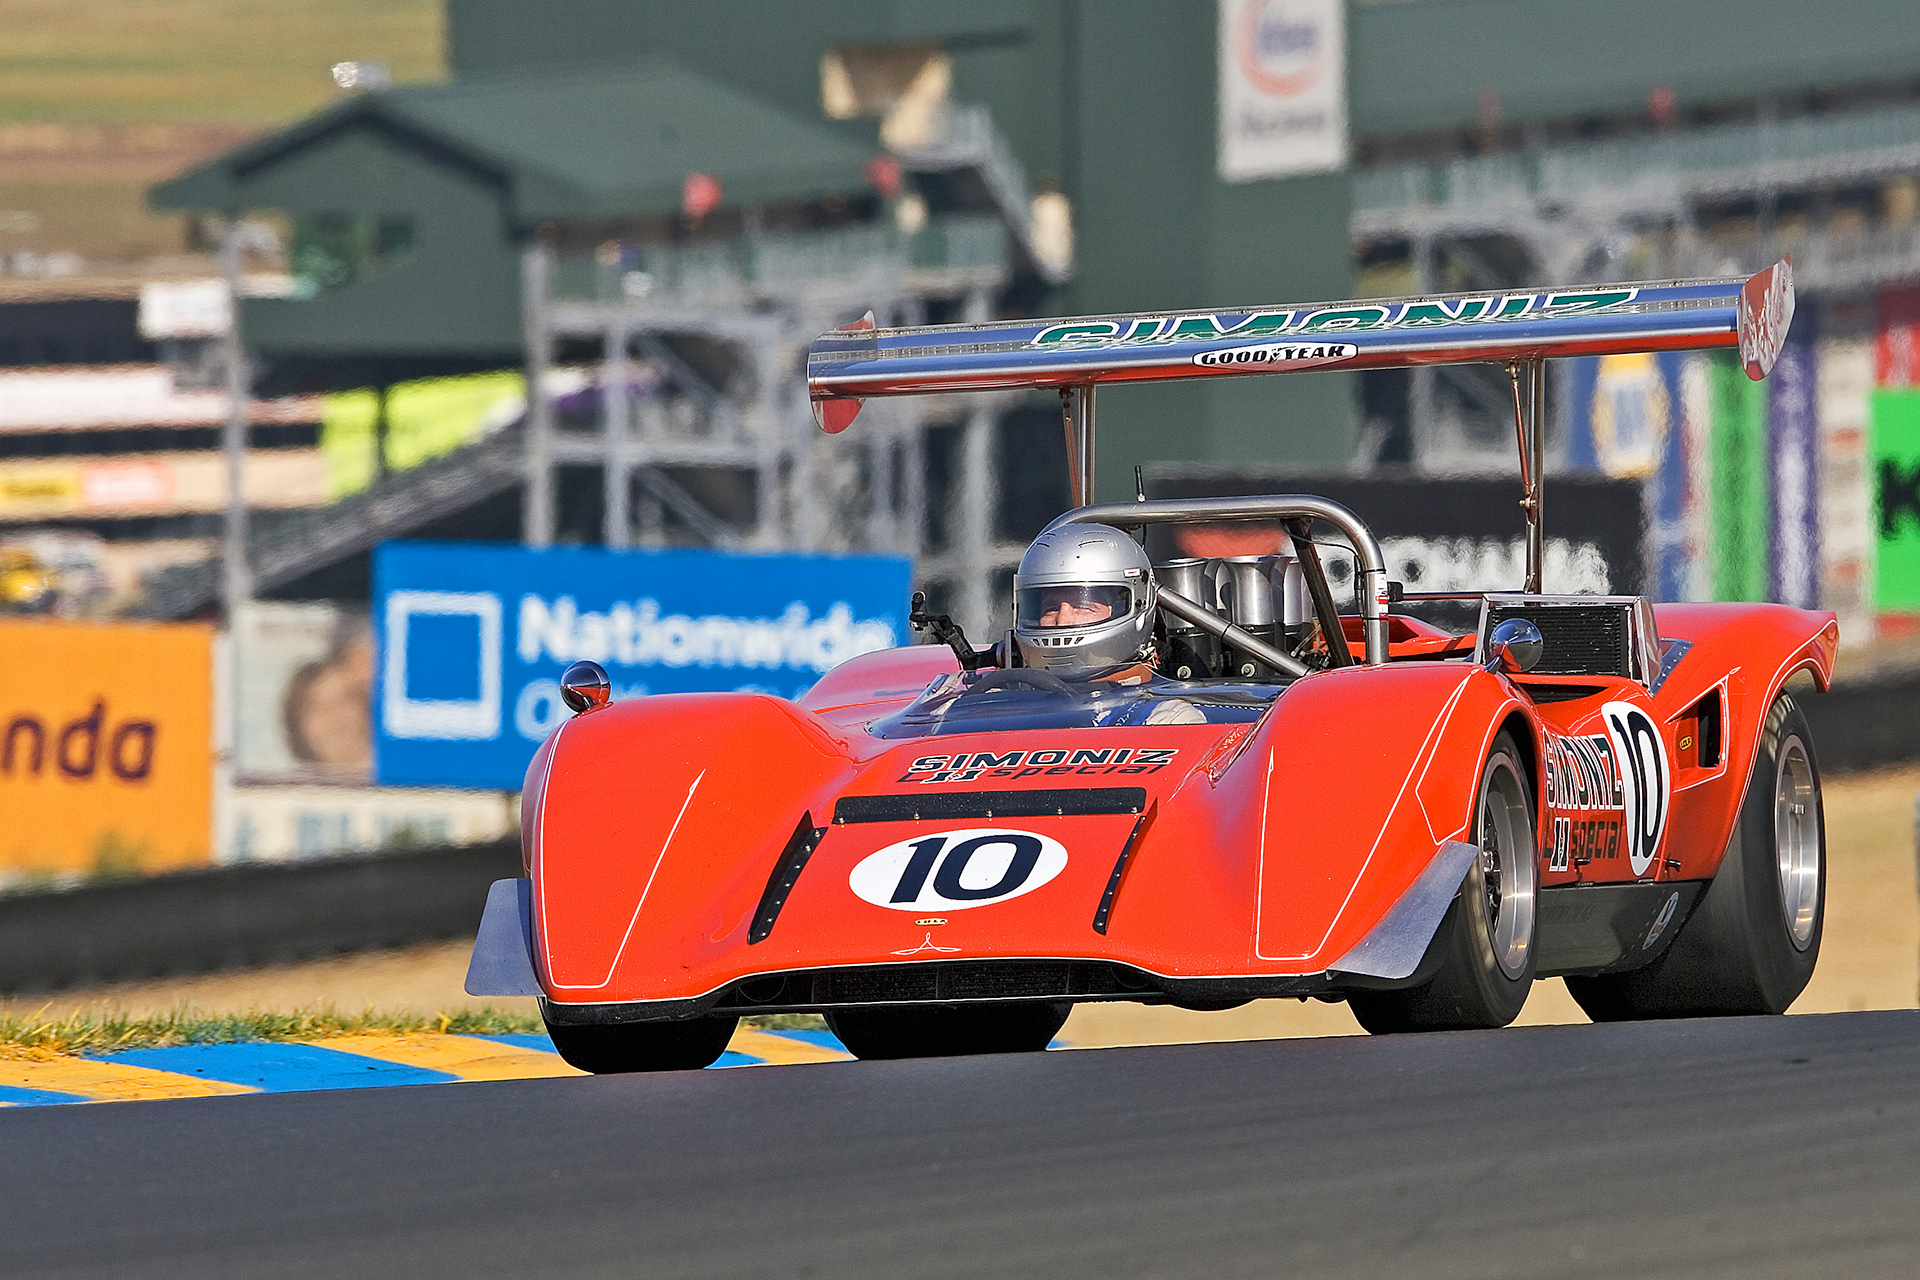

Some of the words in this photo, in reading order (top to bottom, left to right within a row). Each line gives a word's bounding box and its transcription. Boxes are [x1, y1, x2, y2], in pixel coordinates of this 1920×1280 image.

[908, 748, 1180, 772] SIMONIZ
[988, 763, 1167, 780] special
[1542, 724, 1625, 811] SIMONIZ
[1610, 710, 1663, 859] 10
[889, 834, 1043, 904] 10
